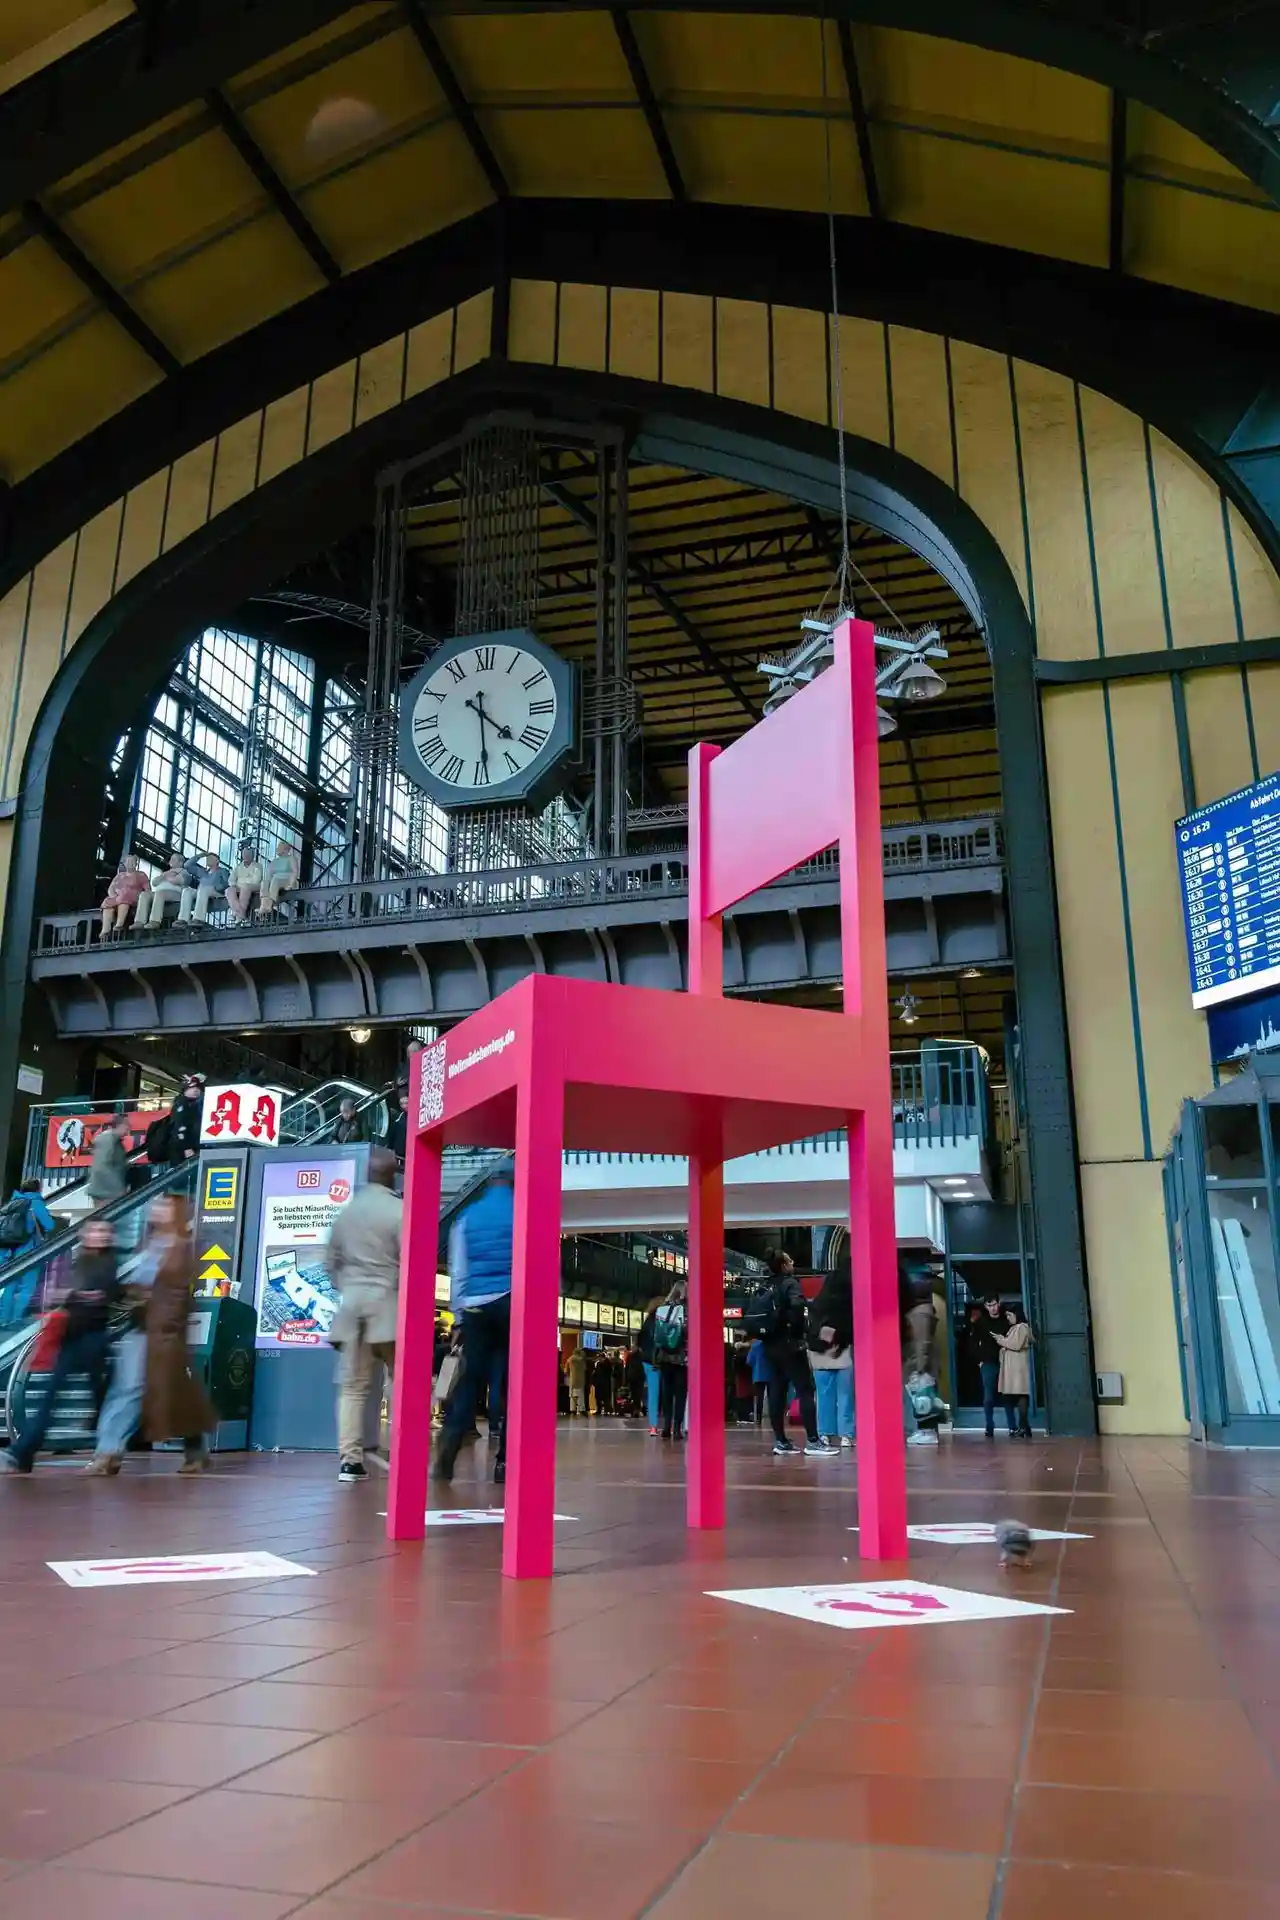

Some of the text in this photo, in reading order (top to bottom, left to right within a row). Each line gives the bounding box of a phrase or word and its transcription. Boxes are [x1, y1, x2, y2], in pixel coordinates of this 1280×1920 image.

[475, 647, 496, 672] XII
[444, 658, 468, 684] XI
[522, 669, 548, 690] II
[423, 687, 448, 703] X
[529, 698, 554, 716] III
[414, 714, 438, 733] IX
[417, 734, 448, 769] VIII
[438, 754, 466, 784] VII
[503, 751, 523, 775] V
[1176, 788, 1254, 827] Willkommen
[300, 1172, 318, 1186] DB
[284, 1205, 304, 1213] bucht
[284, 1213, 311, 1221] liebsten
[278, 1220, 332, 1230] Sparpreis-Ticket
